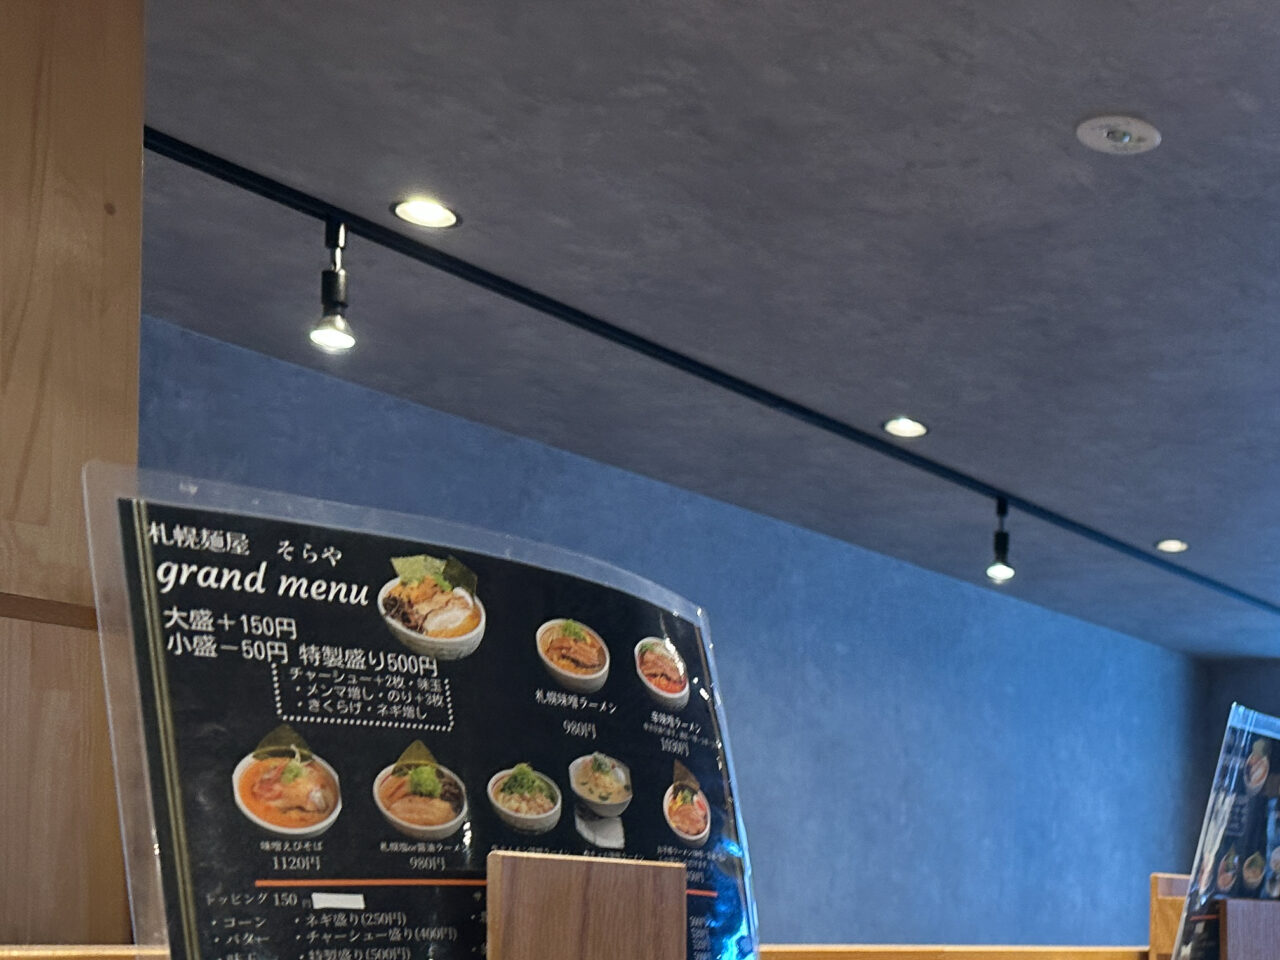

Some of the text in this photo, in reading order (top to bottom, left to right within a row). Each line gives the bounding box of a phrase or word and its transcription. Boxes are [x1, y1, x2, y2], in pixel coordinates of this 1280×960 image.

[149, 520, 342, 567] 札幌麺屋 そらや
[156, 560, 369, 607] grand menu
[298, 642, 438, 678] 特製盛り500円
[271, 856, 322, 871] 1120円
[272, 893, 298, 907] 150
